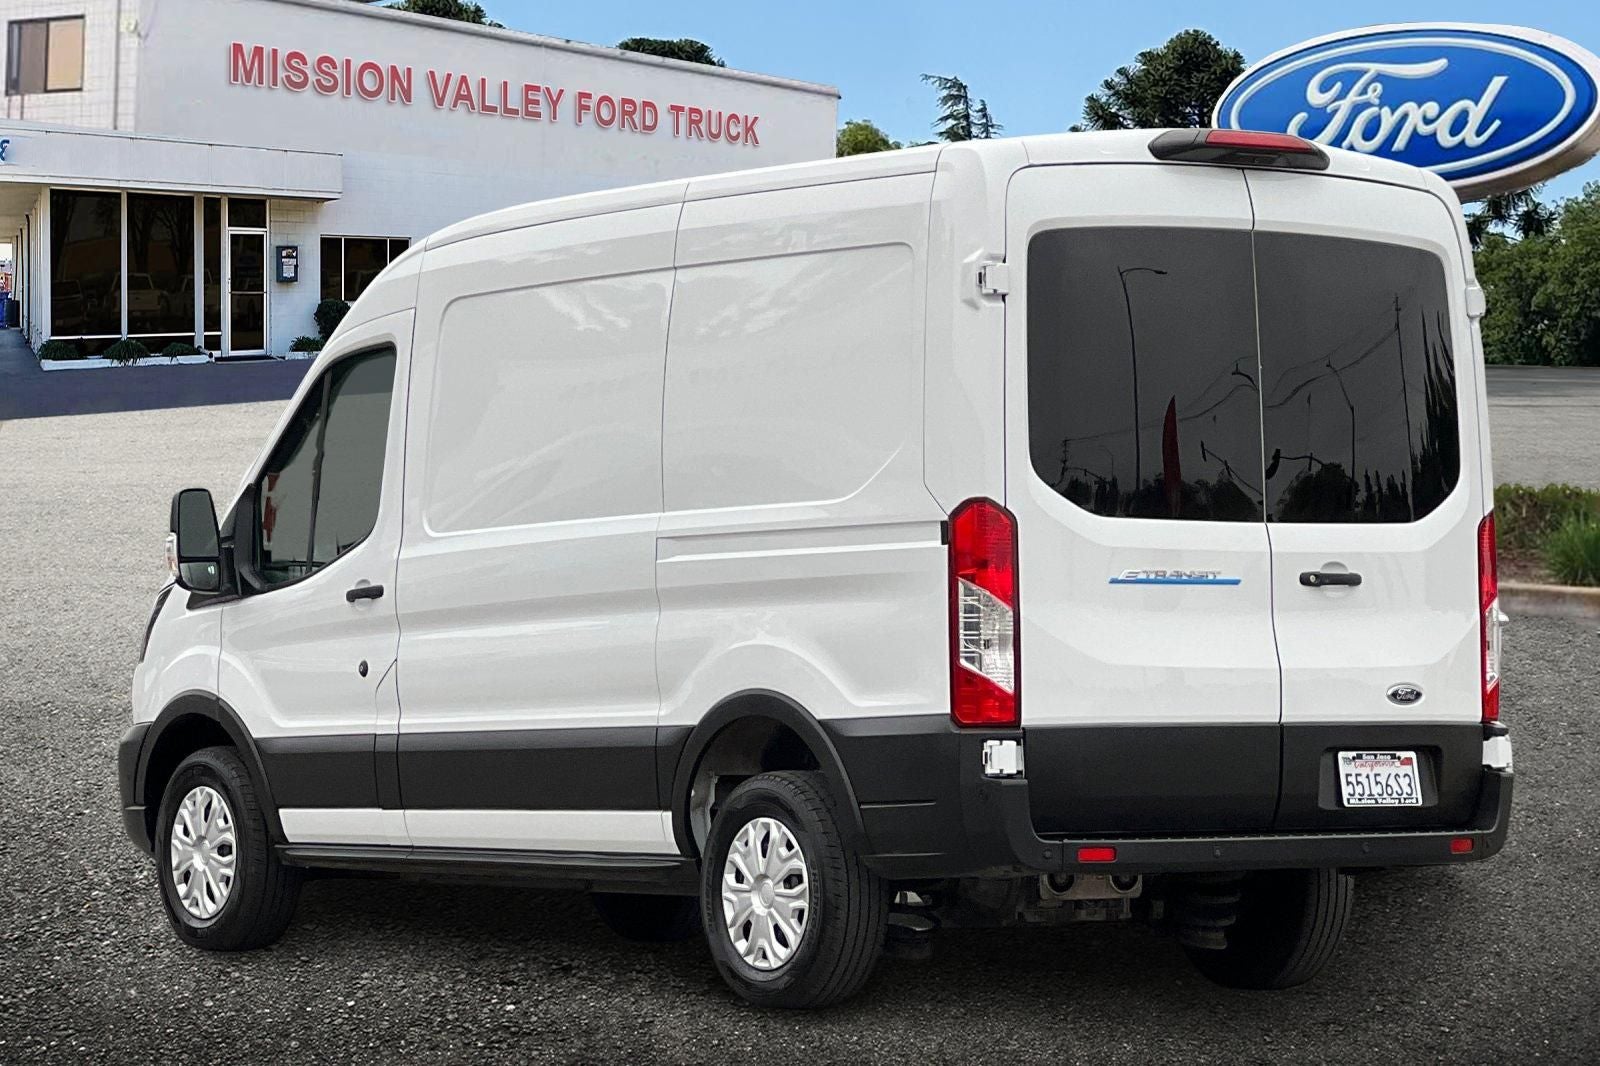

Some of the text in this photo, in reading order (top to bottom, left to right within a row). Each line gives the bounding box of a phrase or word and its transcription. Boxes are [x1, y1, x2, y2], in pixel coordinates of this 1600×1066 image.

[229, 41, 760, 145] MISSION VALLEY FORD TRUCK
[1286, 57, 1509, 154] Ford
[1396, 688, 1417, 700] Ford
[1346, 773, 1413, 797] 55156S3
